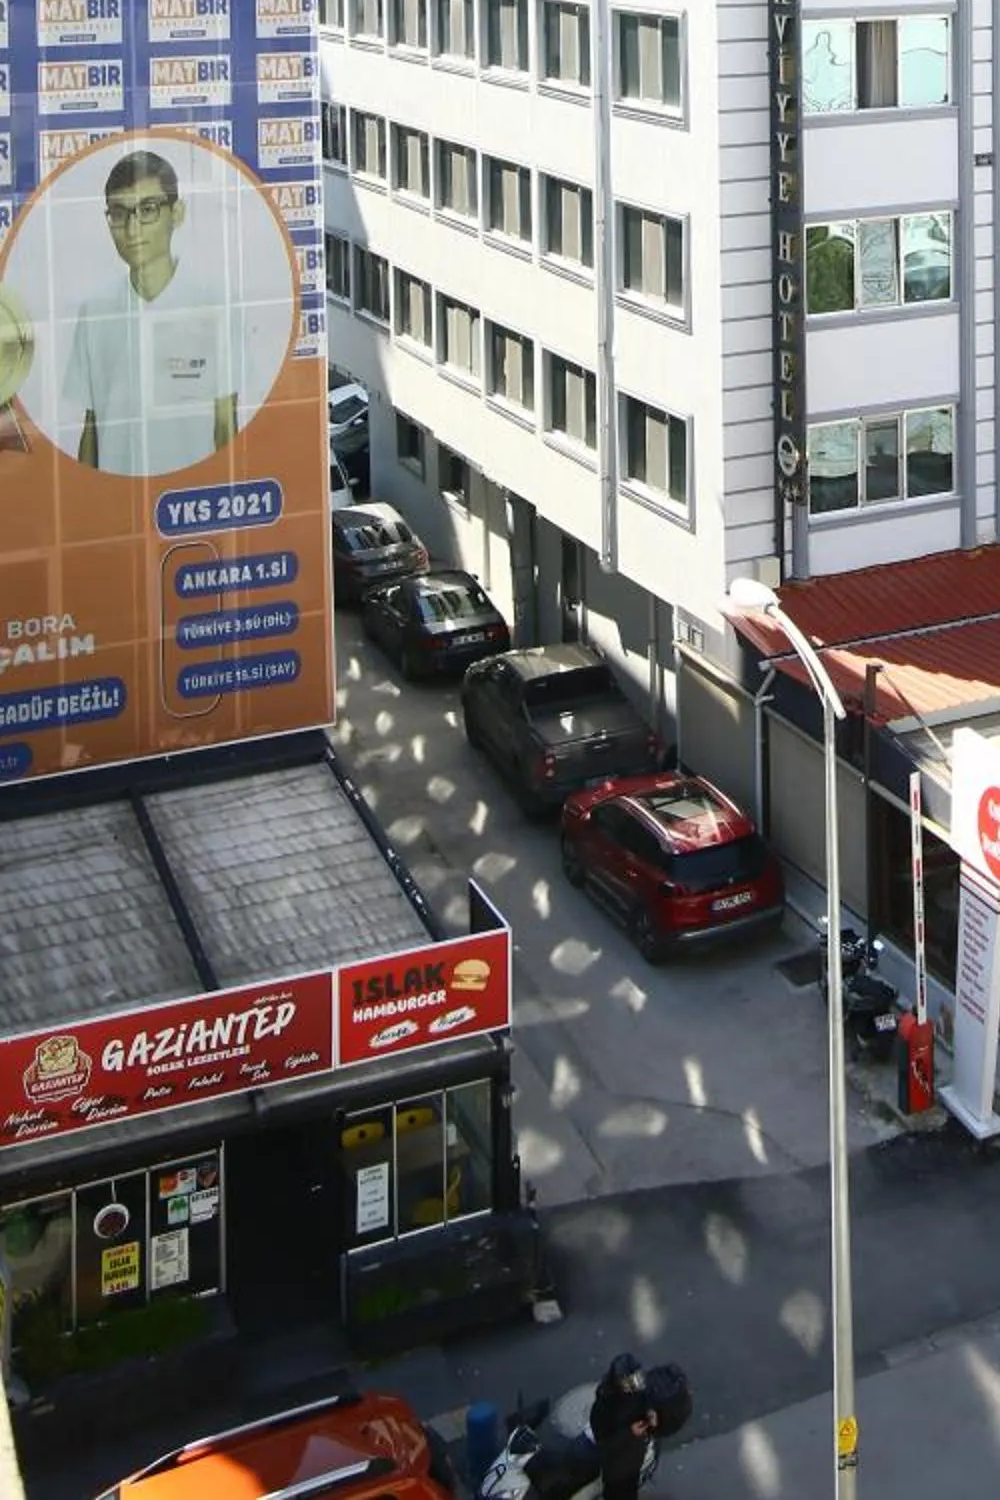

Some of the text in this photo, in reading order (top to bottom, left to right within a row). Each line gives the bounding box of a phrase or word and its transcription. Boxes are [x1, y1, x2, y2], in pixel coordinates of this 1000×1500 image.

[778, 231, 793, 420] HOTEL
[168, 492, 273, 525] YKS 2021
[182, 565, 253, 591] ANKARA
[7, 613, 77, 639] BORA
[184, 621, 233, 641] TÜRKİYE
[184, 670, 233, 691] TÜRKİYE
[57, 686, 120, 717] DEĞİL!
[352, 962, 446, 1003] ISLAK
[352, 989, 447, 1023] HAMBURGER
